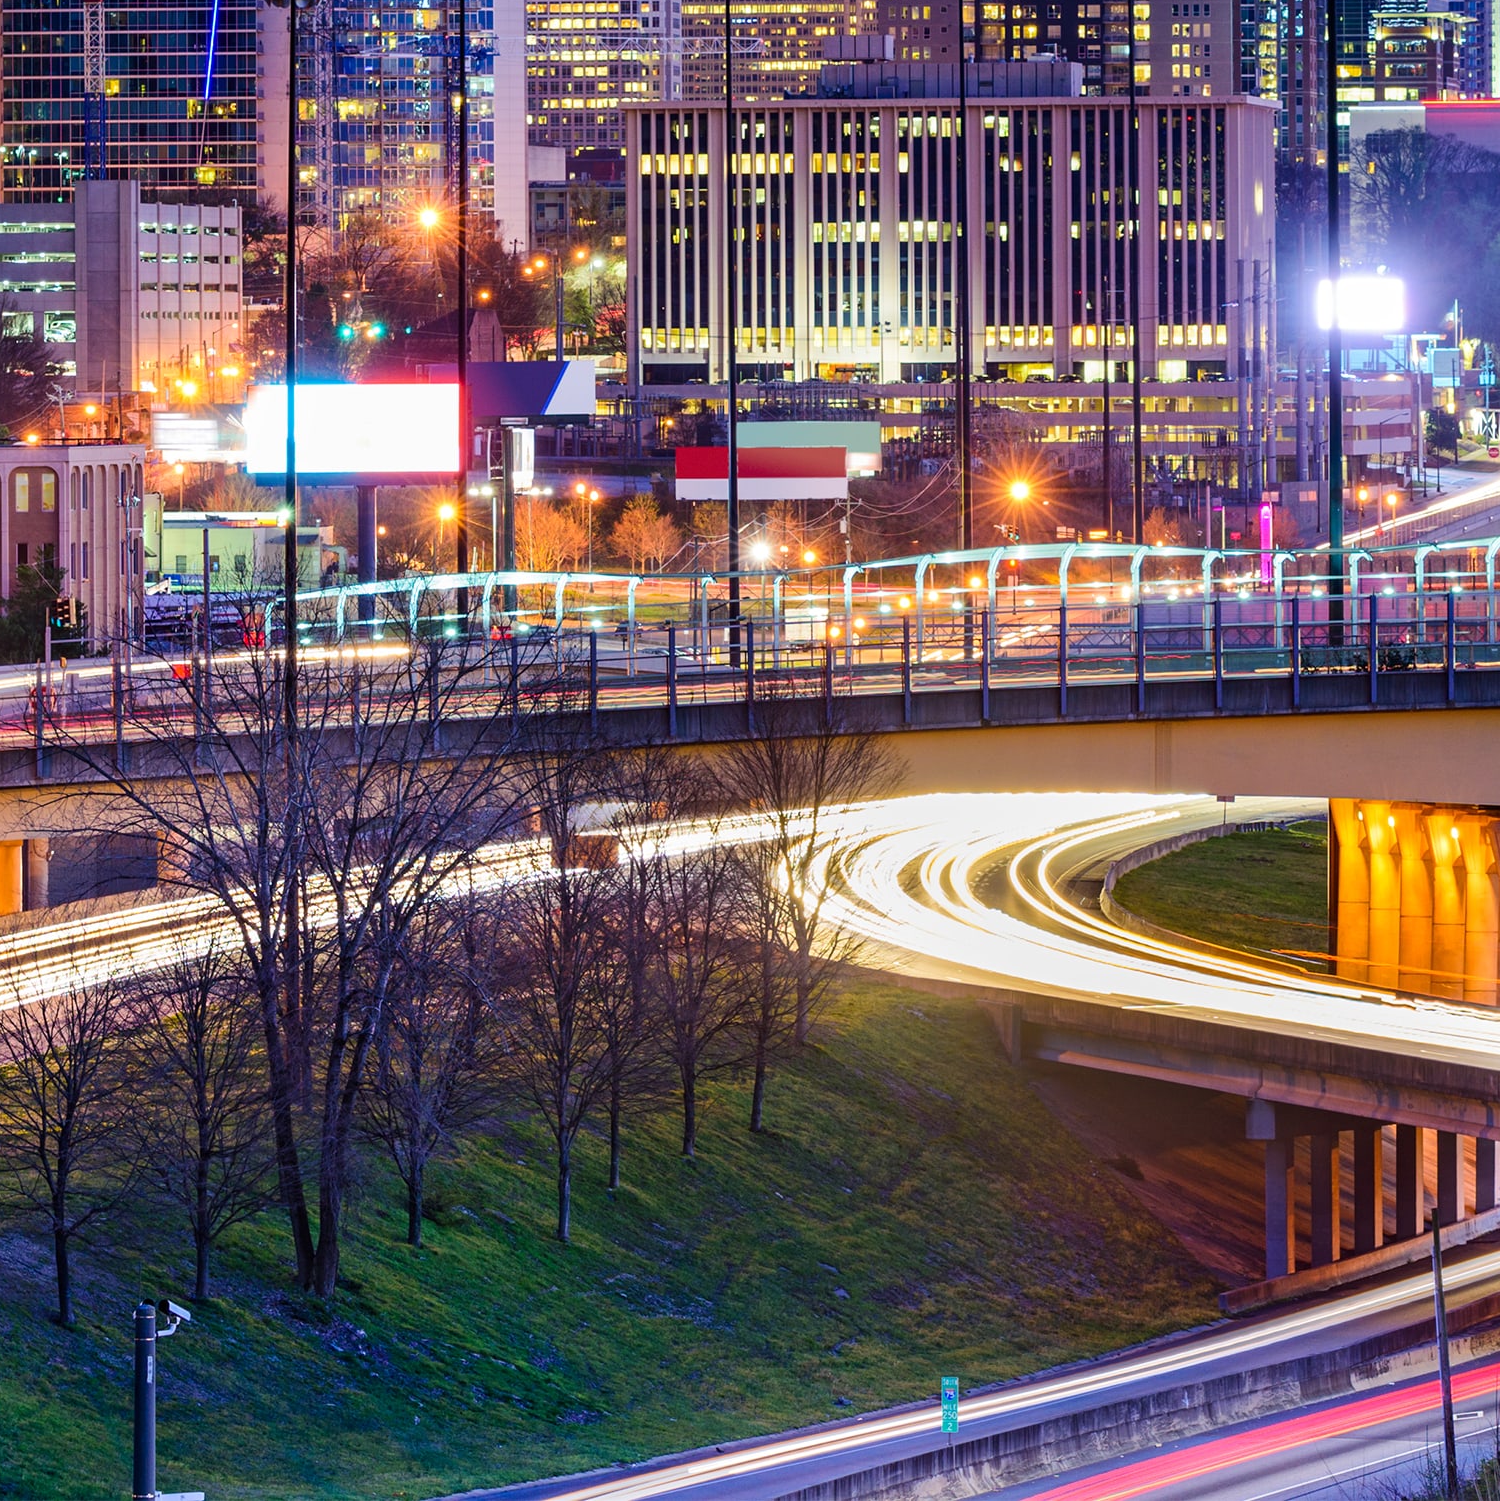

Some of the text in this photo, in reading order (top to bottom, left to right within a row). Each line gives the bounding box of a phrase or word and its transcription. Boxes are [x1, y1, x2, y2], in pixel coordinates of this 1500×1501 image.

[945, 1390, 955, 1399] 75
[943, 1410, 957, 1420] 250
[947, 1422, 953, 1431] 2
